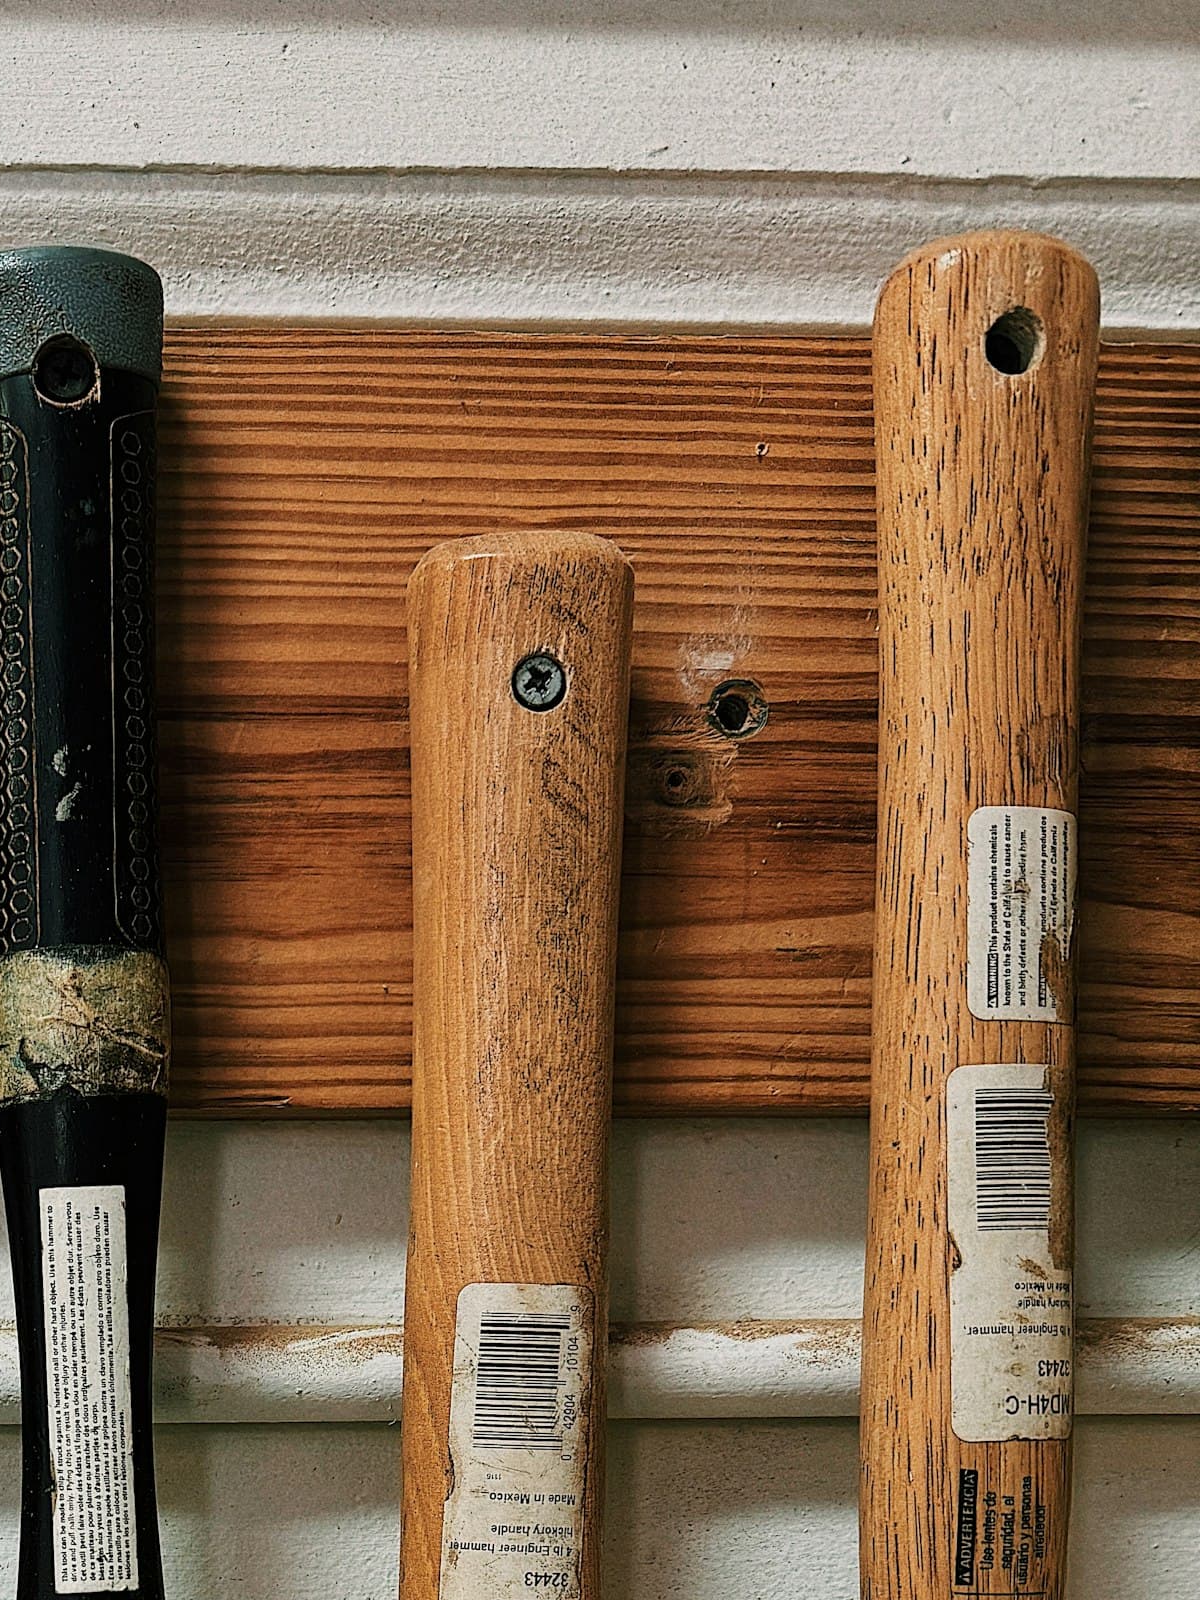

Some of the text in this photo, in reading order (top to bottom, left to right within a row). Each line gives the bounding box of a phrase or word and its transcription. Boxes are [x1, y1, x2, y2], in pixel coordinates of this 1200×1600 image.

[1003, 869, 1011, 877] to
[989, 825, 999, 996] WARNING This product contains chemicals
[1003, 920, 1011, 928] of
[1019, 928, 1026, 937] or
[1003, 931, 1011, 952] State
[1003, 954, 1011, 967] the
[1018, 940, 1026, 968] defects
[1003, 968, 1011, 977] to
[1003, 980, 1011, 1006] known
[1015, 1282, 1045, 1292] Mexico
[1017, 1299, 1046, 1309] handle
[59, 1302, 68, 1331] injuries.
[963, 1325, 1014, 1336] hammer,
[1018, 1323, 1057, 1336] Engineer
[566, 1336, 578, 1372] 10104
[61, 1365, 69, 1385] injury
[1038, 1360, 1070, 1376] 32443
[1006, 1394, 1070, 1415] MD4H-C
[563, 1395, 575, 1430] 42904
[63, 1411, 71, 1431] result
[55, 1417, 63, 1443] against
[58, 1476, 66, 1491] chip
[66, 1470, 74, 1490] Flying
[489, 1492, 575, 1505] Made in Mexico
[1002, 1496, 1014, 1505] el
[1020, 1476, 1032, 1529] personas
[67, 1513, 75, 1529] nails
[960, 1472, 975, 1568] ADVERTENCIA
[60, 1526, 66, 1534] be
[491, 1524, 573, 1537] hickory handle
[980, 1492, 996, 1570] Use lentes de
[445, 1540, 495, 1554] hammer,
[498, 1542, 549, 1554] Engineer
[567, 1546, 572, 1556] 4
[1017, 1543, 1029, 1585] usuario
[525, 1572, 569, 1587] 32443
